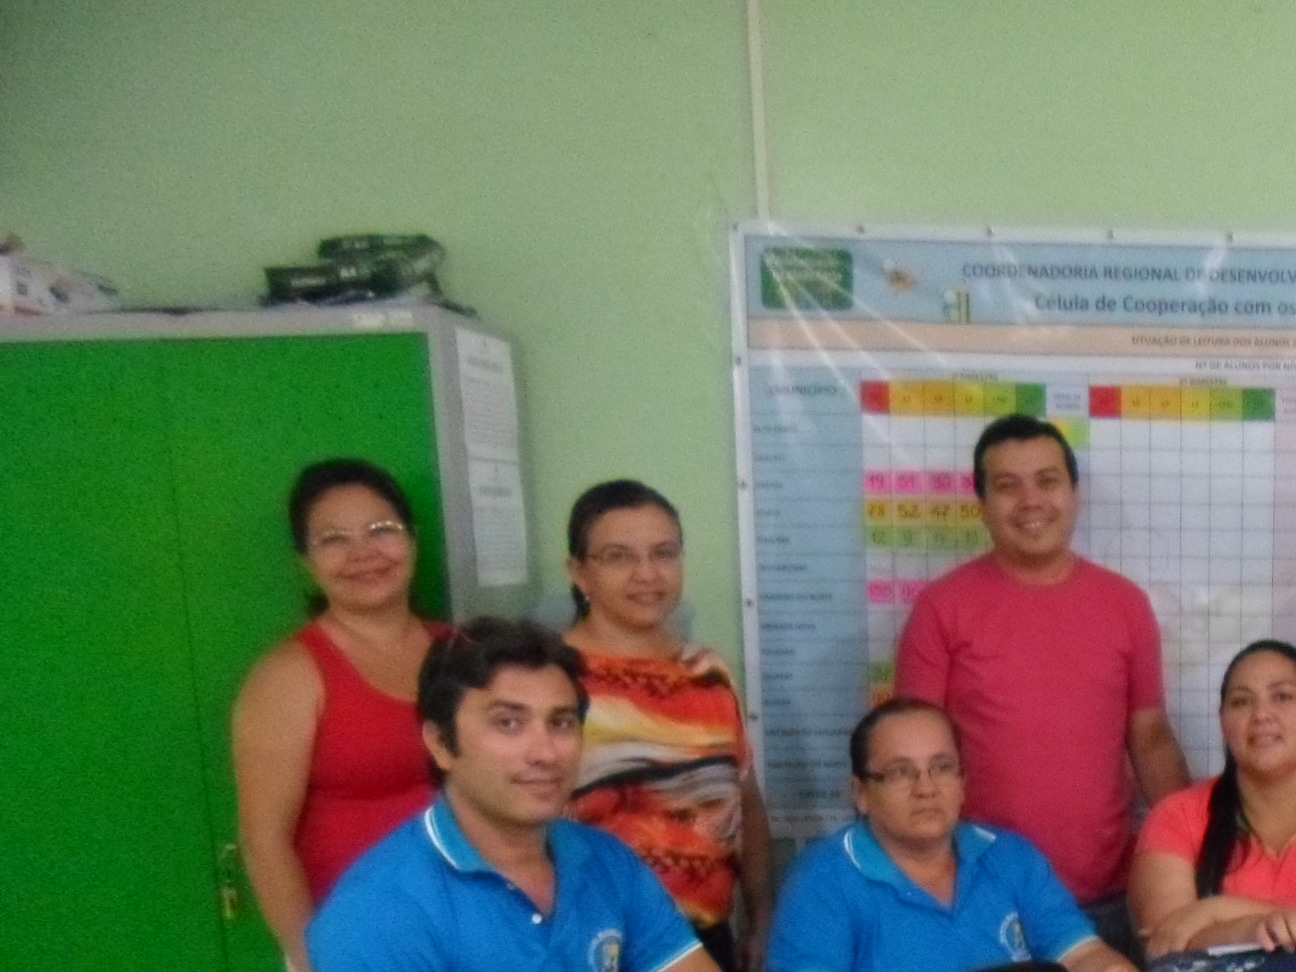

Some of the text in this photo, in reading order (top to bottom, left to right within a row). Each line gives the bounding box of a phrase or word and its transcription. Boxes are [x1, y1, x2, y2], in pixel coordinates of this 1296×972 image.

[1104, 265, 1179, 282] REGIONAL
[1095, 296, 1117, 312] de
[1123, 297, 1228, 317] Cooperação
[1234, 300, 1271, 315] com
[1277, 303, 1296, 316] os
